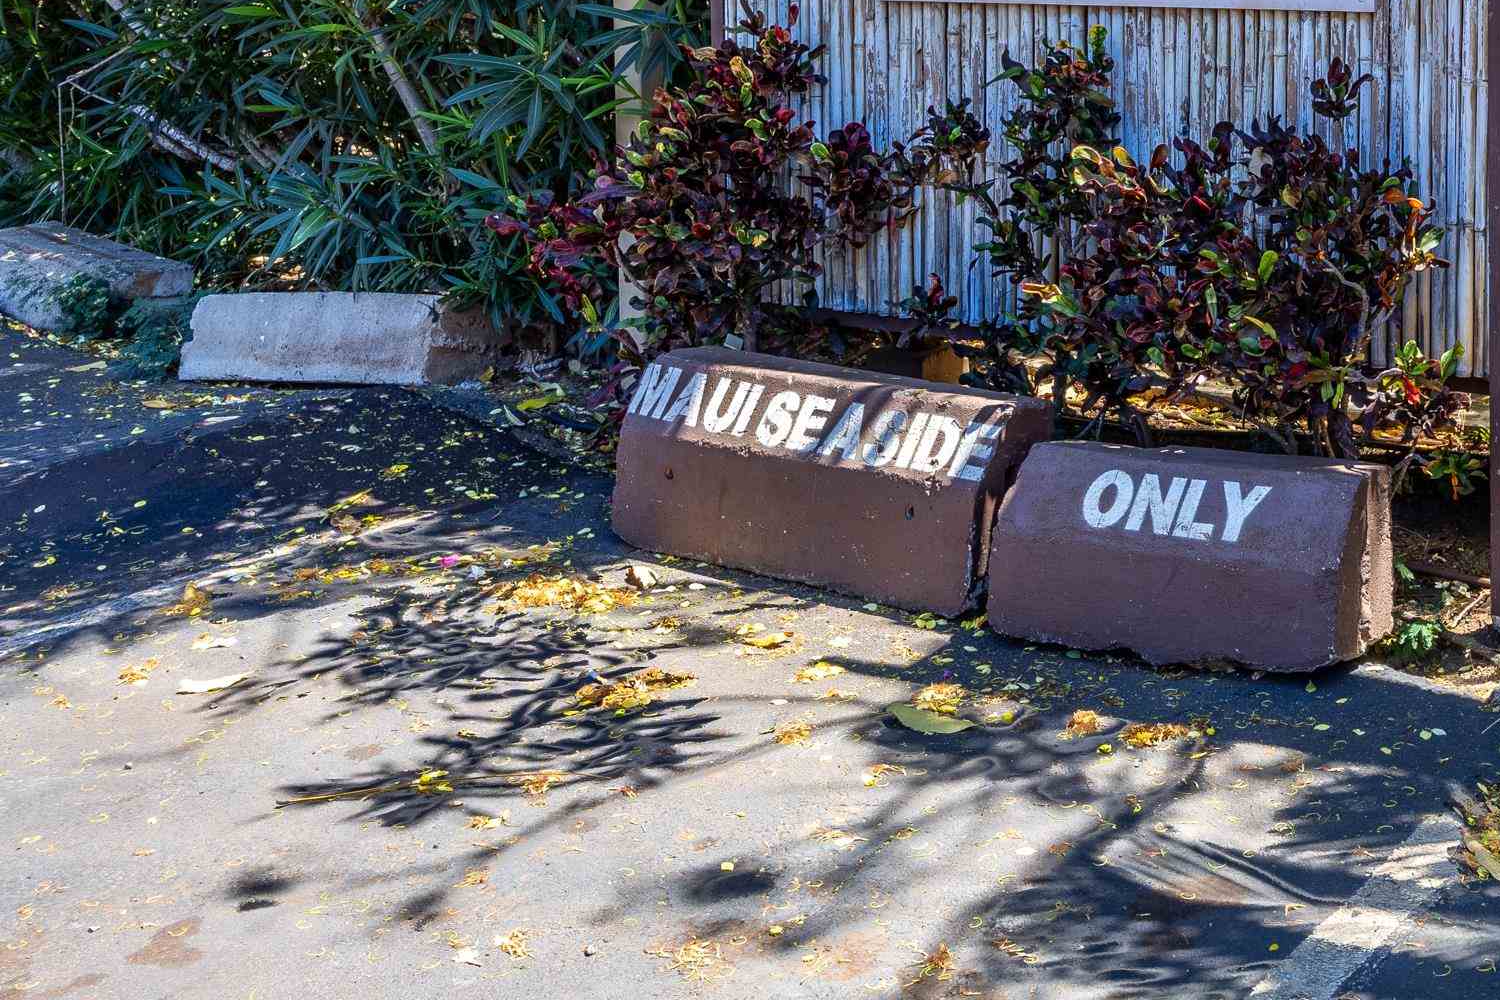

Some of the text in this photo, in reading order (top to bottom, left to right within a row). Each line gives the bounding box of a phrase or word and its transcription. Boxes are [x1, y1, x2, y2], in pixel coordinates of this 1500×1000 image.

[626, 362, 1004, 481] MAUI SEASIDE
[1082, 469, 1273, 543] ONLY
